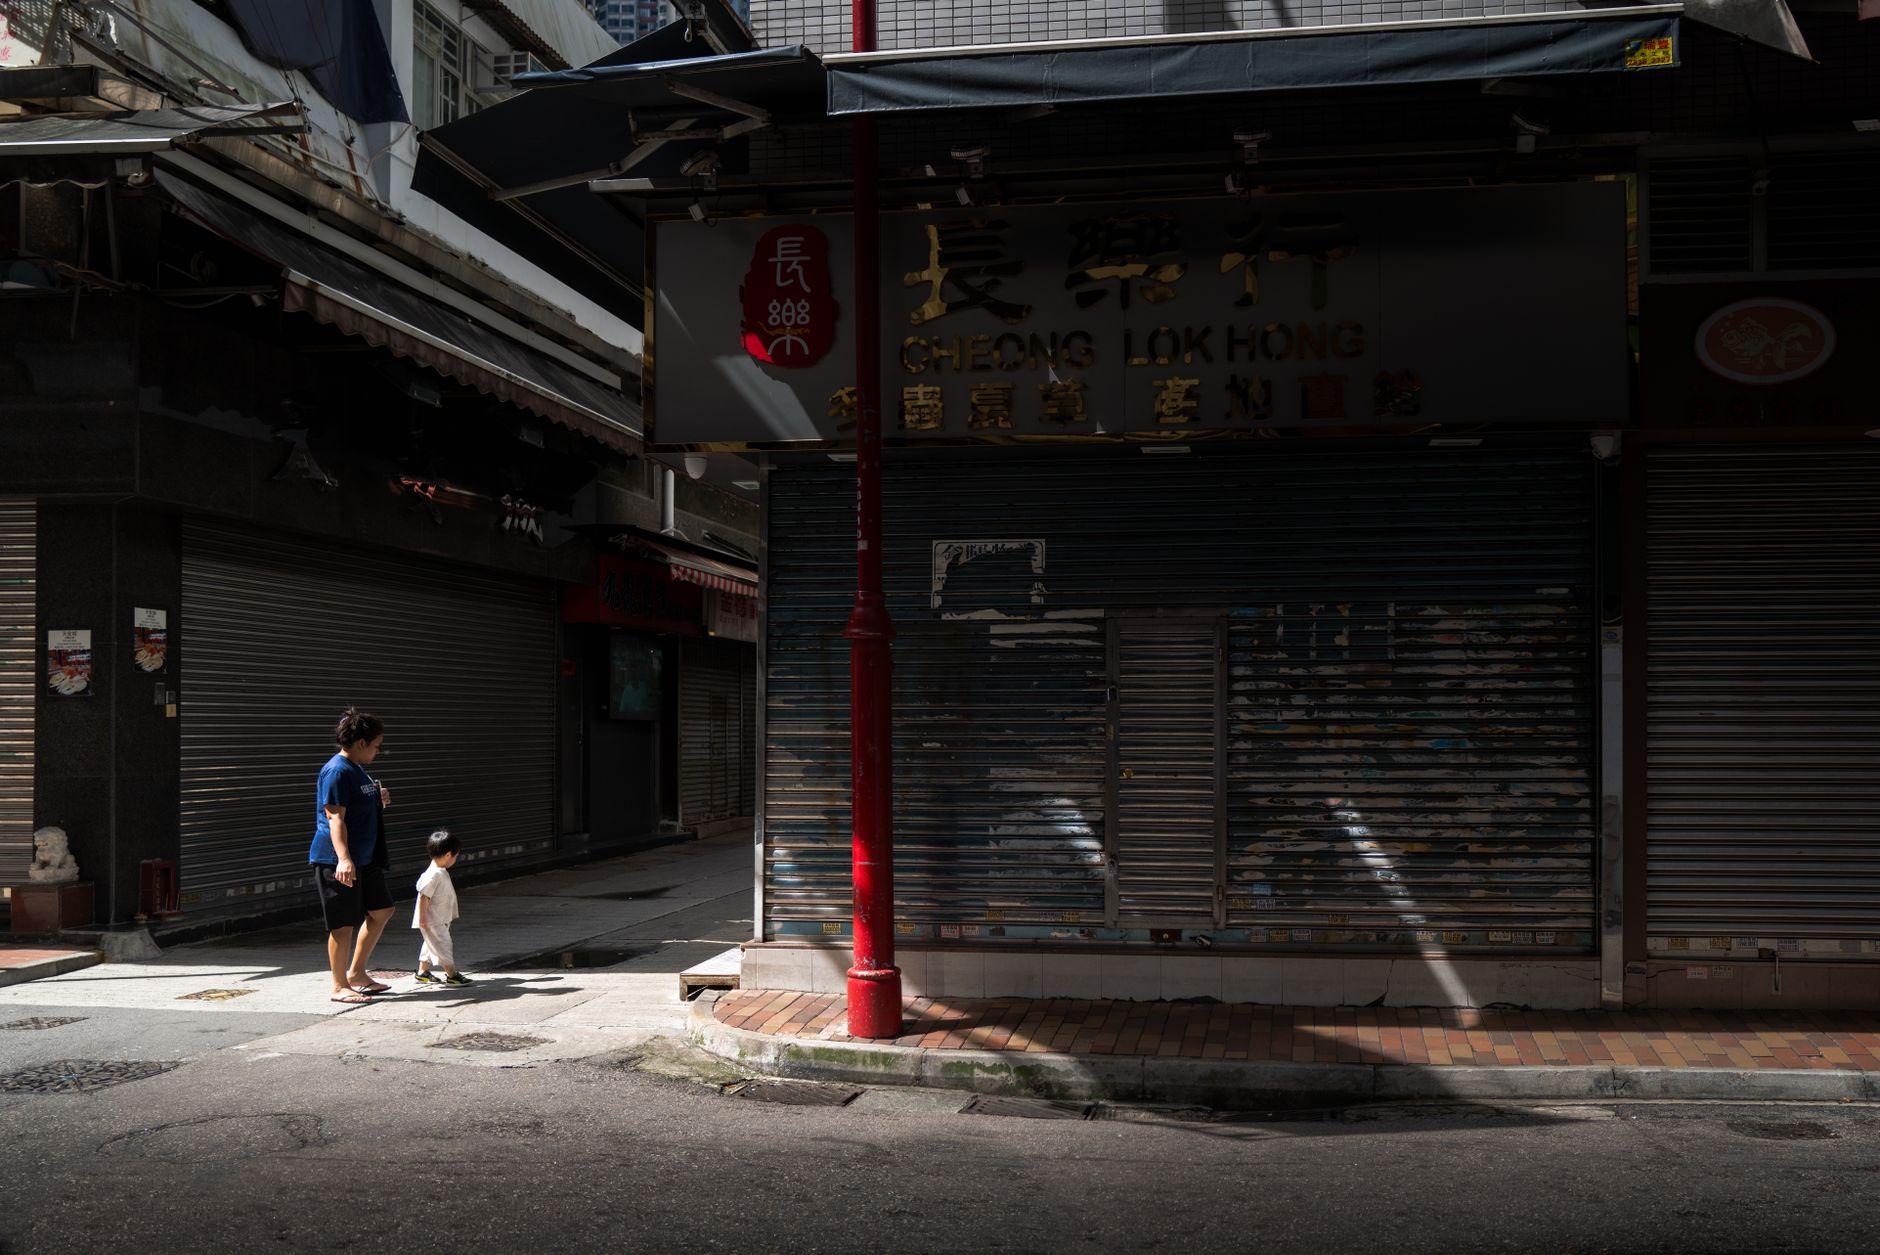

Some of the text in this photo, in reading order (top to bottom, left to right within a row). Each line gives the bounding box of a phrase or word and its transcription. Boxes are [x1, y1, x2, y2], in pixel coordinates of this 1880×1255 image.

[768, 236, 812, 357] 長樂
[900, 320, 1366, 375] CHEONG LOK HONG
